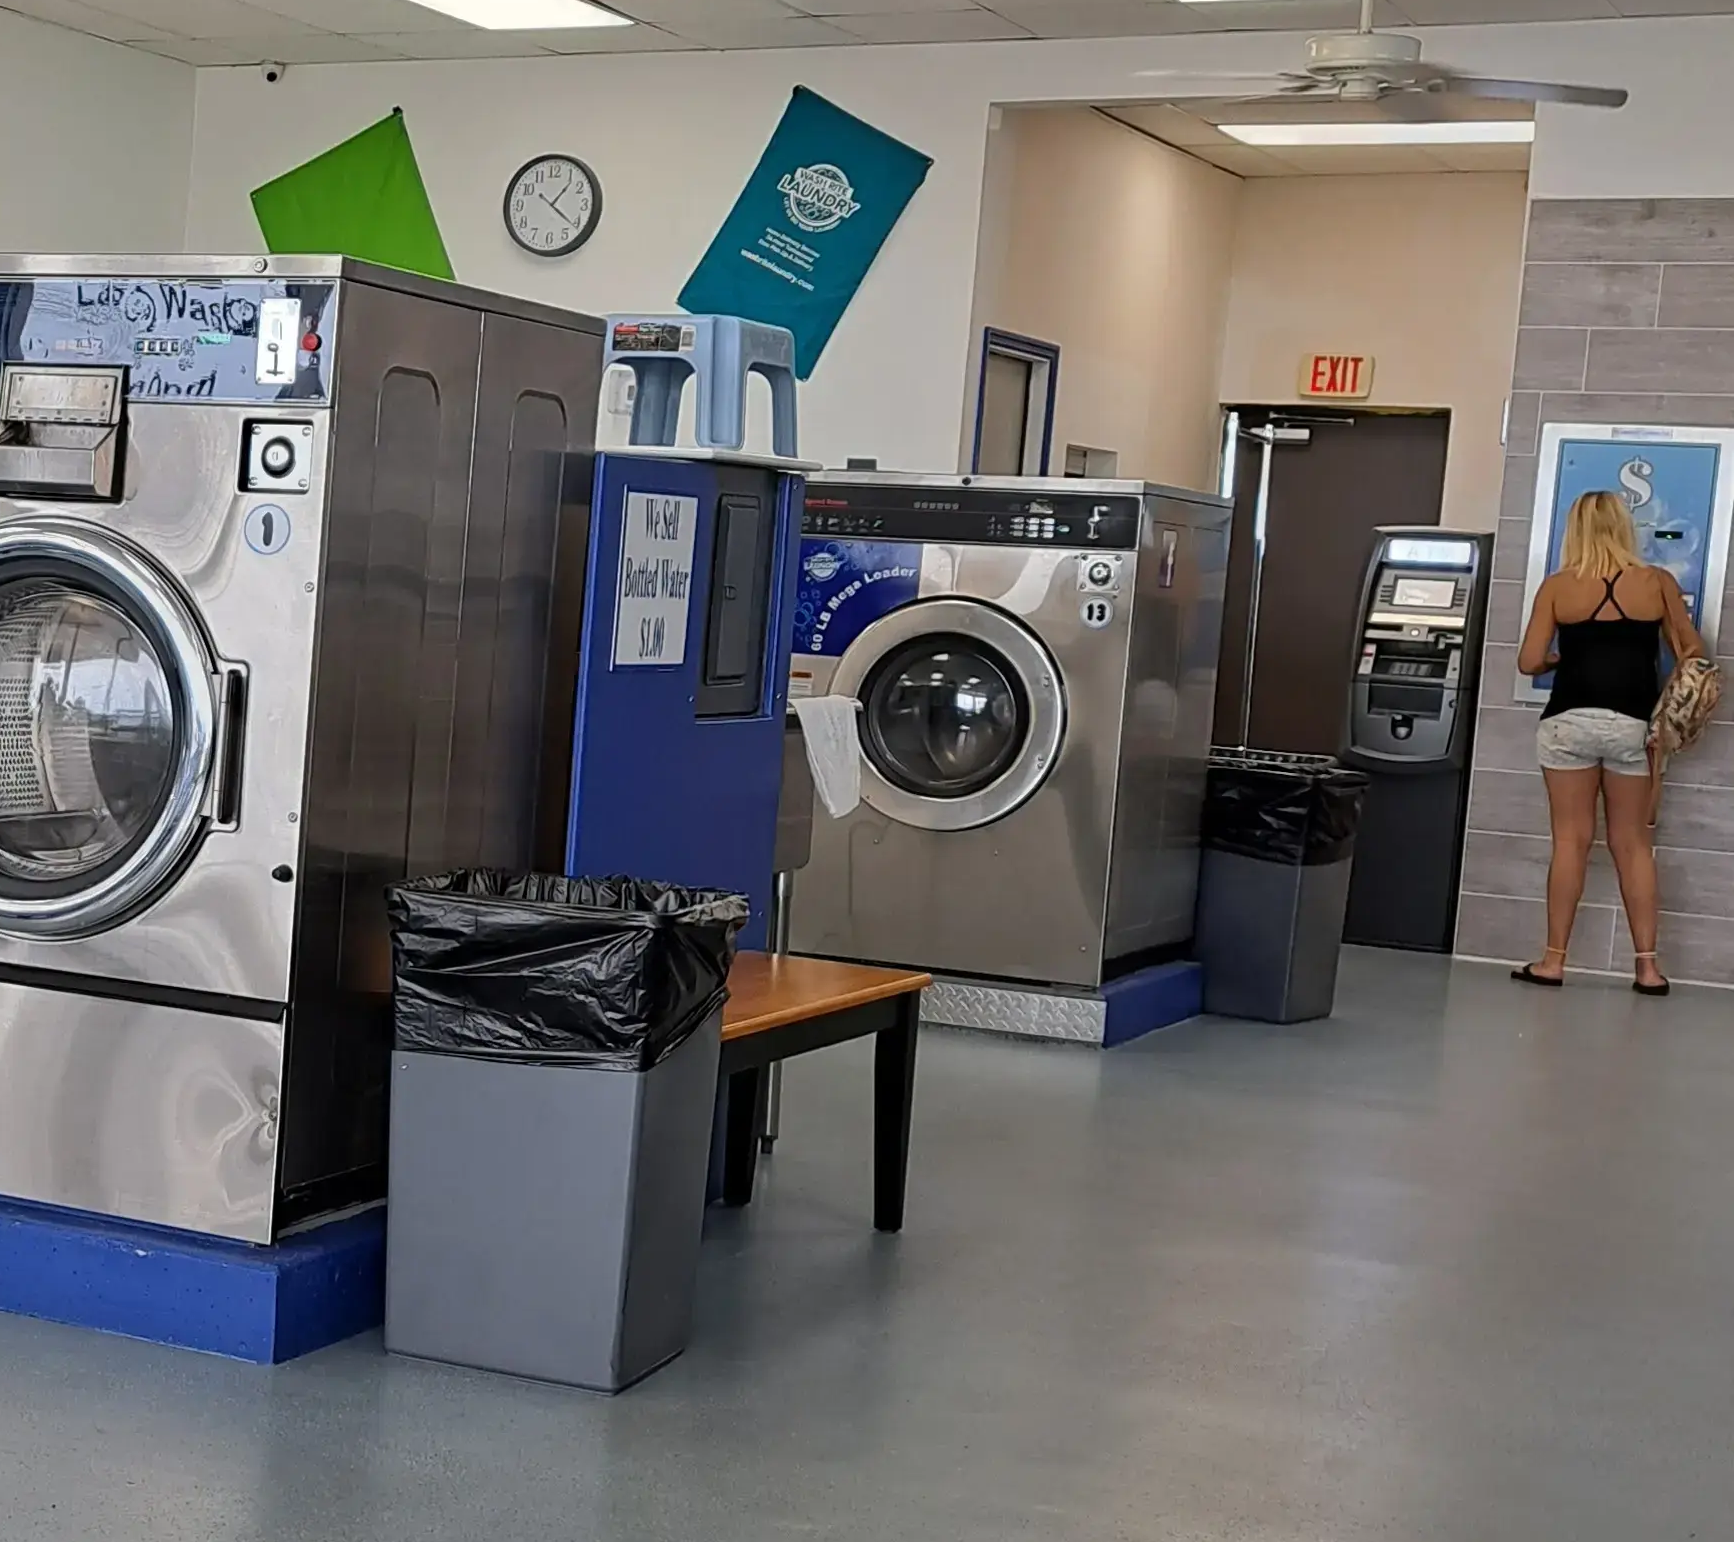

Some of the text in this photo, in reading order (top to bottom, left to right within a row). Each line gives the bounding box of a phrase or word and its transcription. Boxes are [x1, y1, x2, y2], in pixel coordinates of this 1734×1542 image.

[535, 170, 544, 183] 11
[548, 165, 561, 178] 12
[523, 183, 534, 196] 10
[576, 181, 584, 194] 2
[799, 170, 850, 197] WASH RITE
[779, 175, 859, 216] LAUNDRY
[516, 199, 524, 212] 9
[580, 198, 589, 211] 3
[520, 216, 527, 229] 8
[531, 228, 538, 240] 7
[546, 232, 553, 245] 6
[561, 228, 569, 240] 5
[1311, 355, 1364, 393] EXIT
[646, 498, 681, 540] We Sell
[624, 556, 690, 600] Bottled Water
[827, 580, 863, 611] Mega
[864, 565, 918, 584] Loader
[1087, 603, 1108, 622] 13
[639, 616, 666, 660] $1.00
